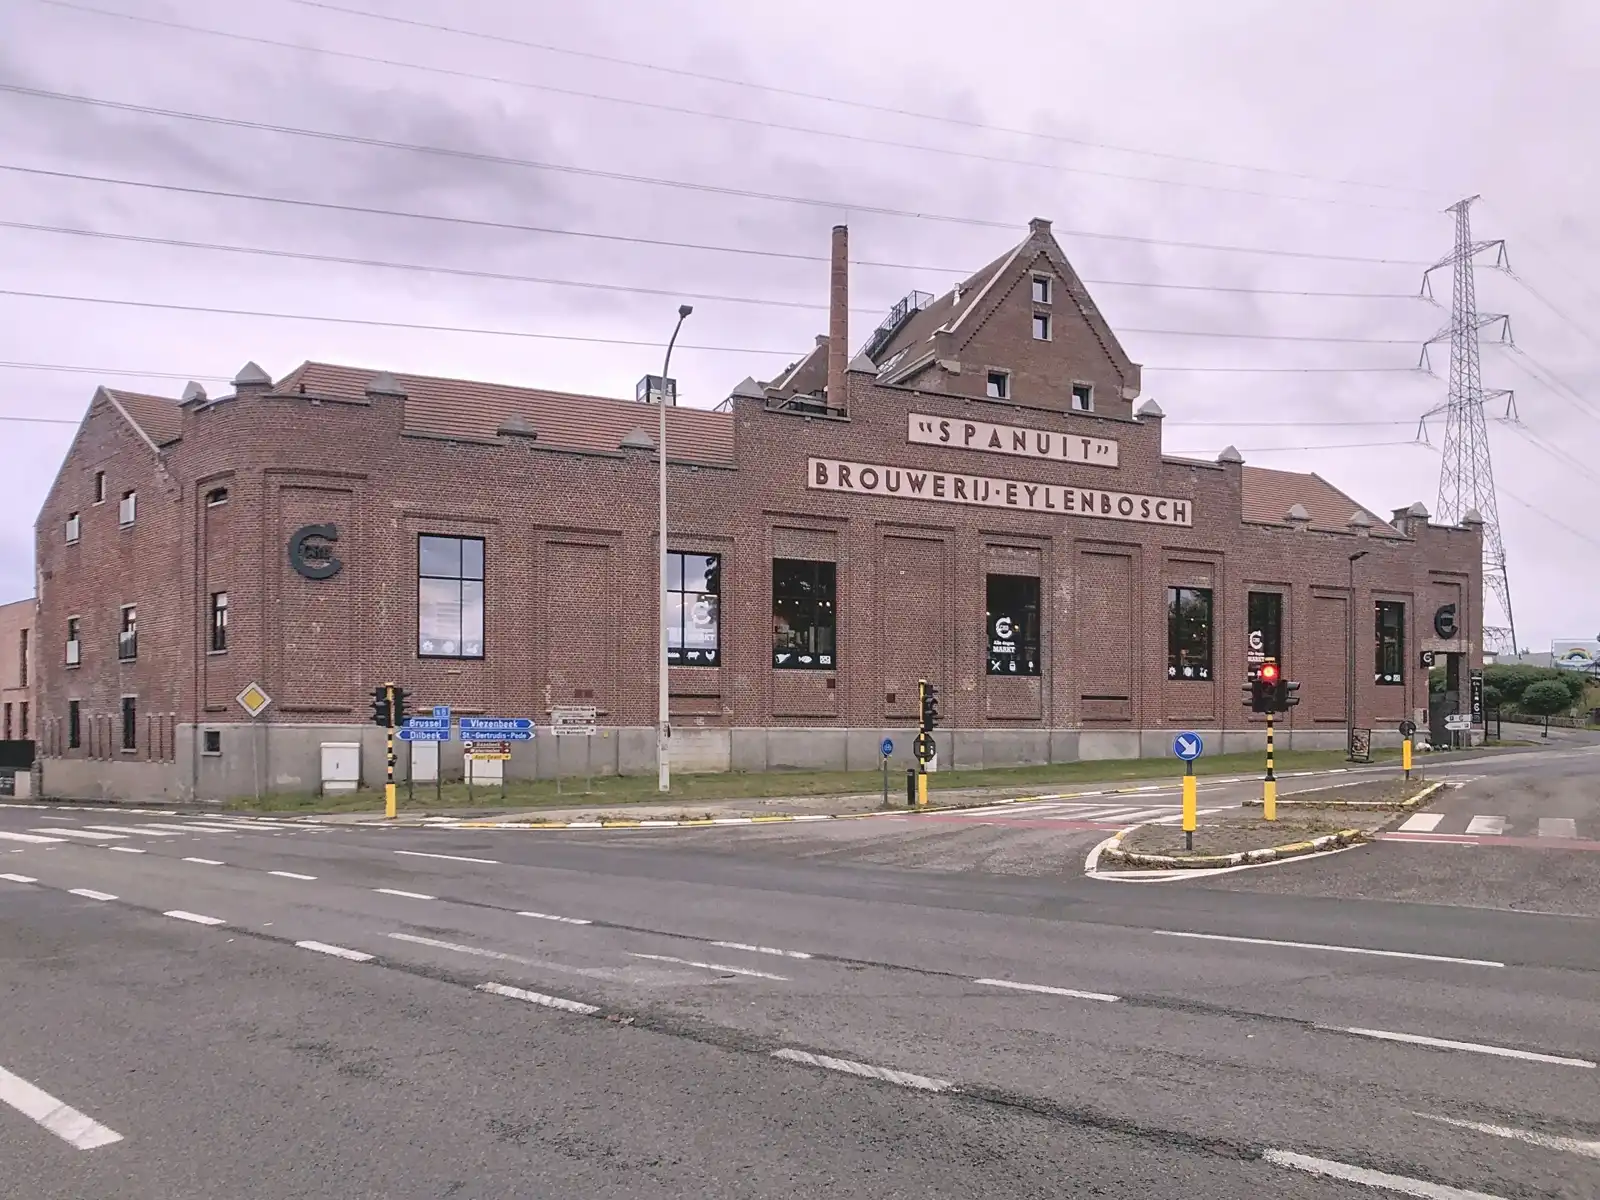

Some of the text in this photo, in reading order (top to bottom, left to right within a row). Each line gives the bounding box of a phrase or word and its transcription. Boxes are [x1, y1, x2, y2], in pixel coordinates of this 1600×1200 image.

[409, 719, 442, 728] Brussel
[470, 719, 519, 728] Vlezenbeek
[409, 730, 441, 739] Dilbeek
